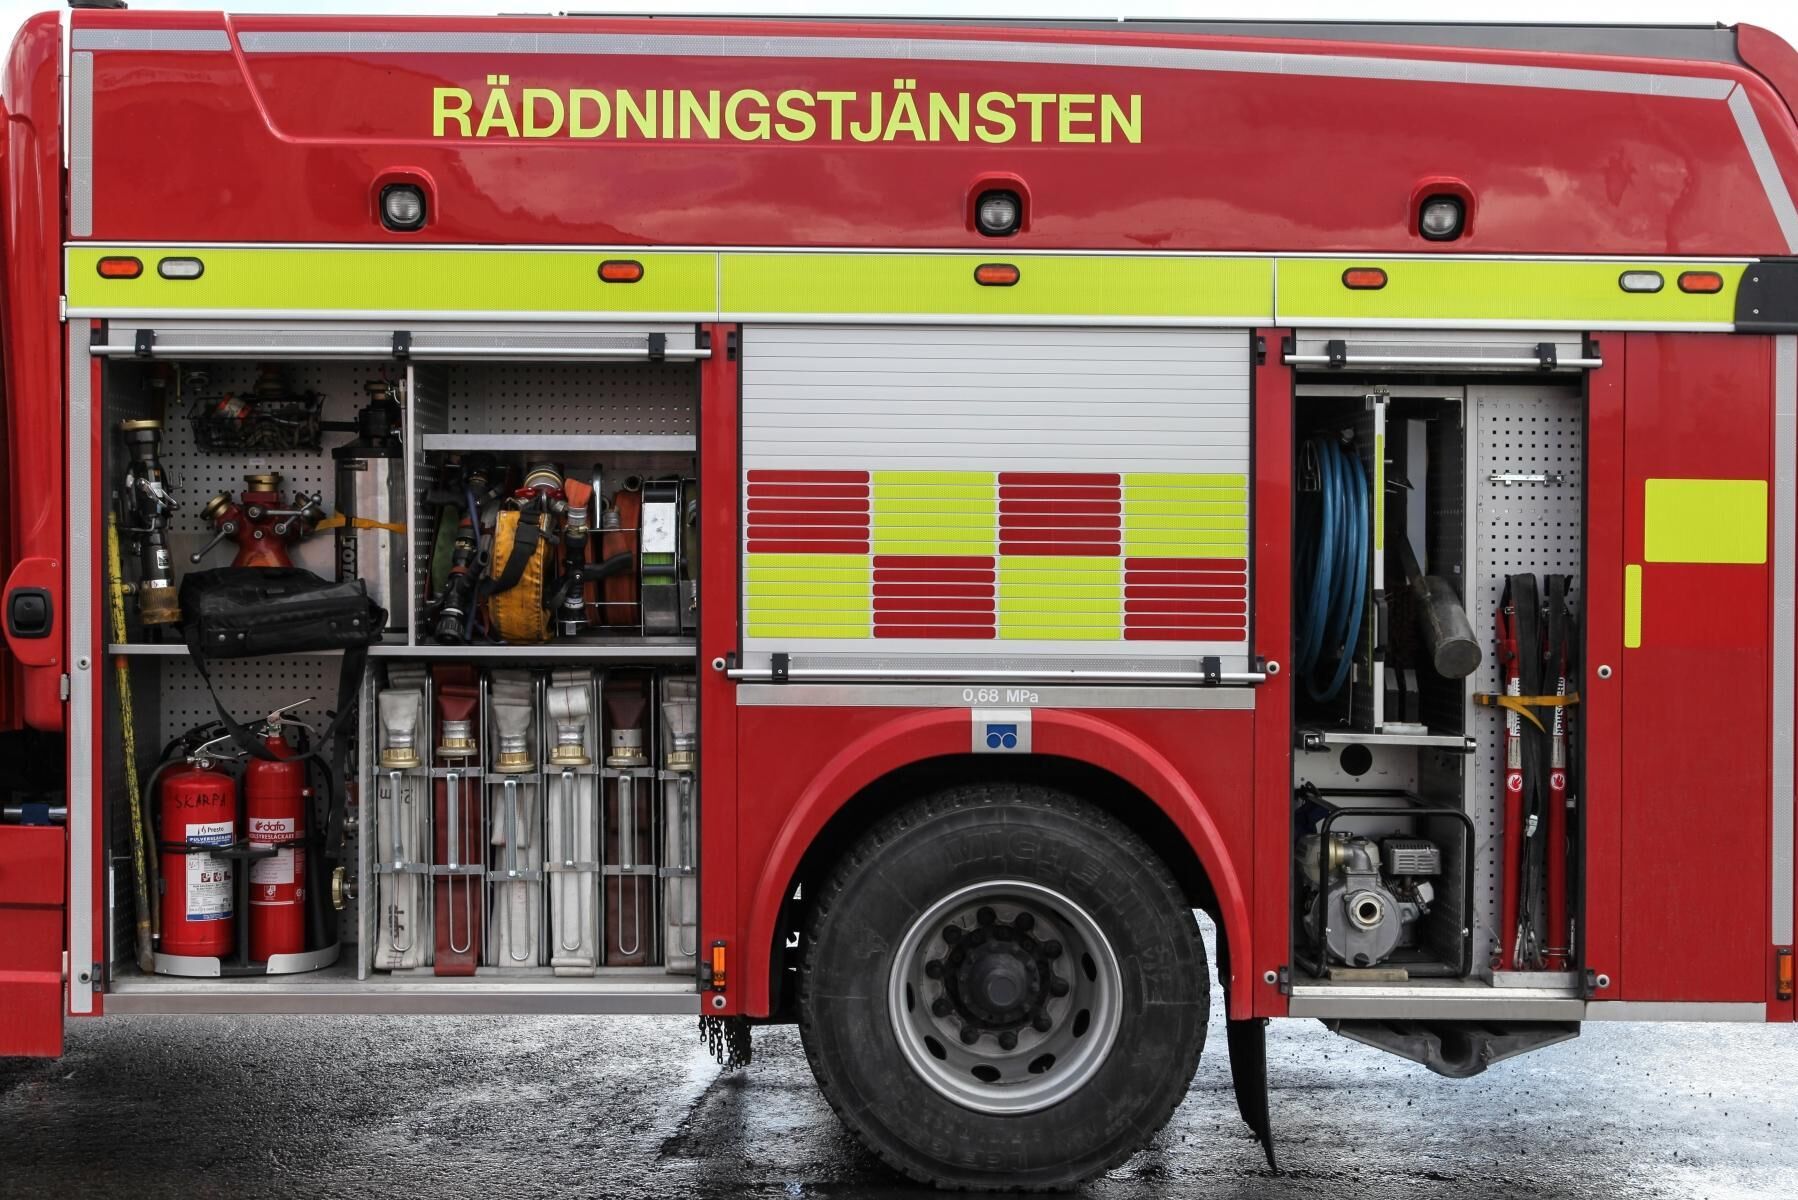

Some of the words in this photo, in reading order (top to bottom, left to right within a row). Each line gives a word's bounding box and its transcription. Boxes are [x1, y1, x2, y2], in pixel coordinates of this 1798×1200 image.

[432, 75, 1142, 143] RÄDDNINGSTJÄNSTEN
[962, 688, 999, 704] 0,68
[1006, 689, 1039, 703] MPa
[175, 792, 227, 808] SKARPA
[207, 825, 225, 833] Presto
[263, 822, 286, 831] dafo
